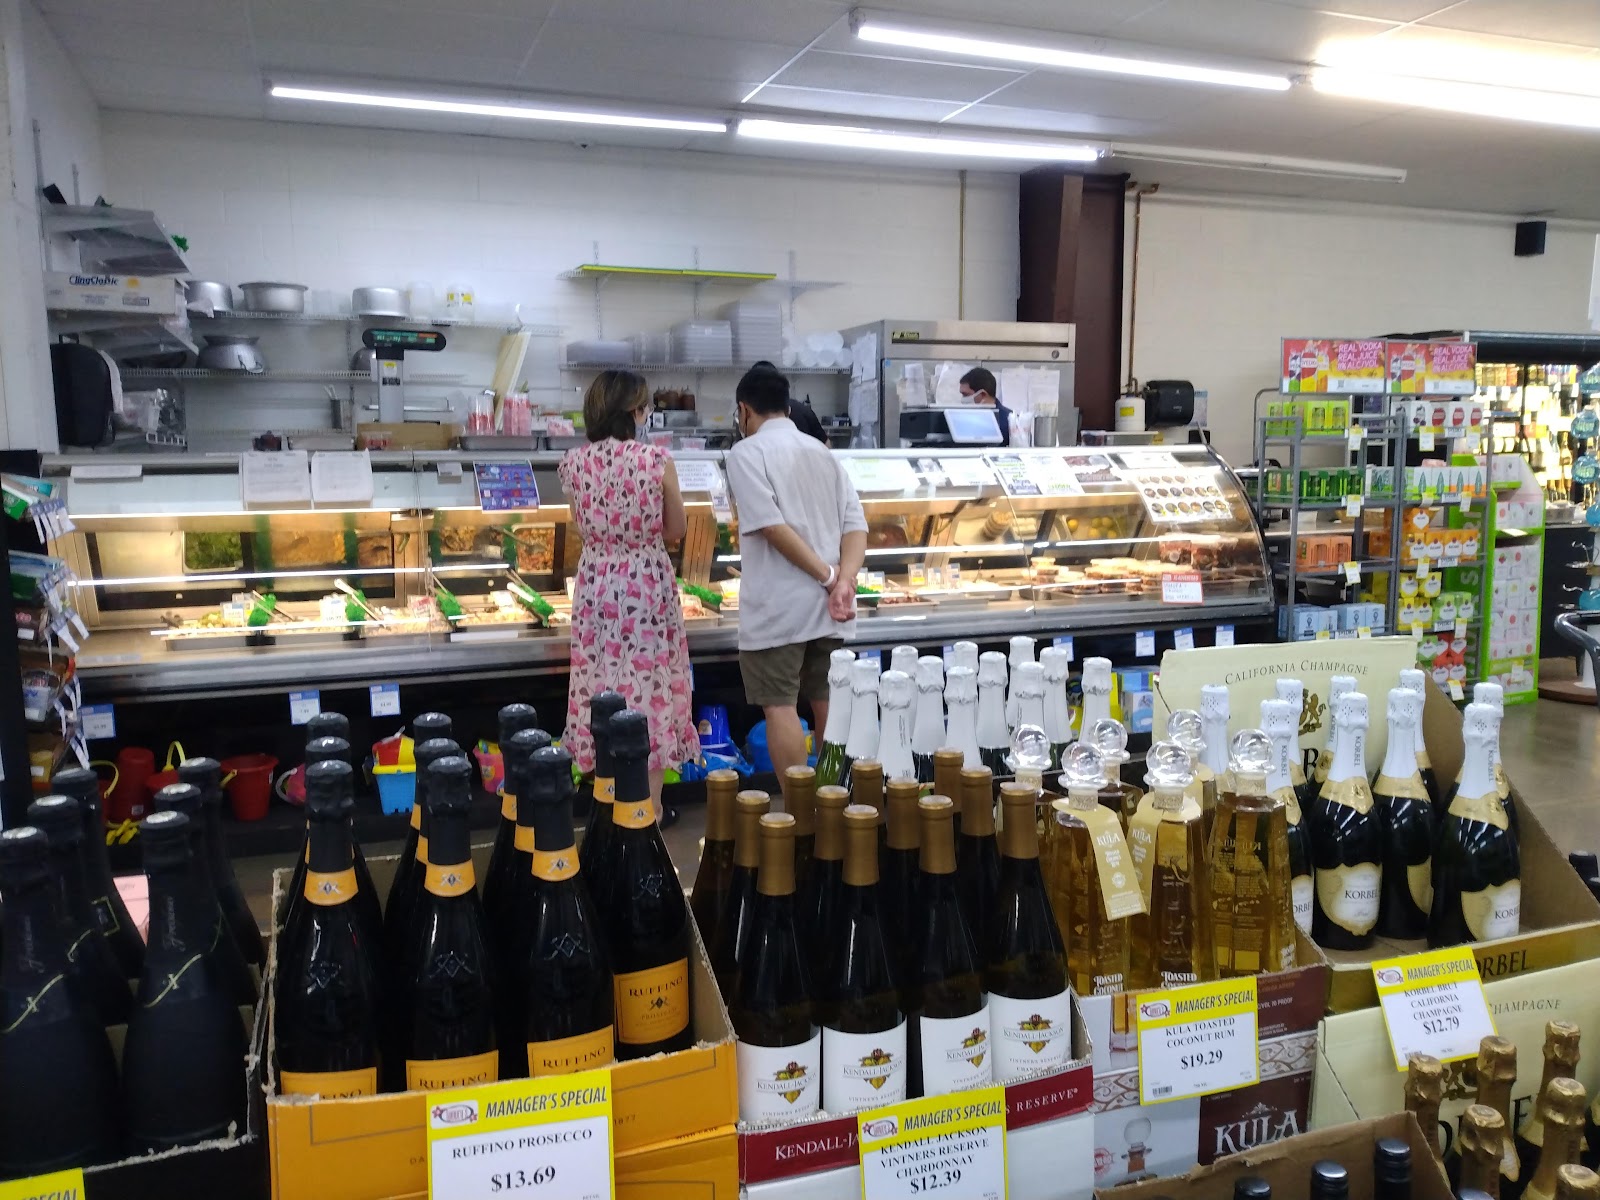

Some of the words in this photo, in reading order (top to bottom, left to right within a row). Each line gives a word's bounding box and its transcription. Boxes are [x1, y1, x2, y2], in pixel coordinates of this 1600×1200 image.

[1338, 343, 1357, 352] REAL
[1359, 341, 1383, 350] VODKA
[1338, 352, 1356, 361] REAL
[1357, 351, 1378, 360] JUICE
[1434, 347, 1450, 356] REAL
[1452, 345, 1473, 354] VODKA
[1433, 356, 1449, 364] REAL
[1452, 354, 1468, 363] JUICE
[1225, 662, 1296, 685] CALIFORNIA
[1300, 659, 1369, 676] CHAMPAGNE
[1353, 736, 1361, 767] KORBEL
[1487, 749, 1495, 782] KORBEL
[1096, 832, 1121, 847] KULA
[1344, 889, 1379, 900] KORBEL
[1093, 973, 1123, 986] TOASTED
[1161, 970, 1197, 982] TOASTED
[1406, 961, 1447, 981] MANAGER'S
[1446, 958, 1475, 974] SPECIAL
[629, 976, 684, 997] RUFFINO
[1404, 986, 1436, 998] KORBEL
[1437, 982, 1459, 992] BRUT
[1175, 994, 1222, 1014] MANAGER'S
[1223, 990, 1255, 1006] SPECIAL
[1278, 997, 1293, 1005] PROOF
[1411, 993, 1460, 1009] CALIFORNIA
[1413, 1004, 1464, 1021] CHAMPAGNE
[1165, 1025, 1192, 1037] KULA
[1194, 1016, 1236, 1032] TOASTED
[1423, 1016, 1461, 1036] $12.79
[1167, 1033, 1213, 1049] COCONUT
[1214, 1029, 1236, 1041] RUM
[542, 1045, 607, 1069] RUFFINO
[1180, 1049, 1224, 1071] $19.29
[419, 1071, 488, 1089] RUFFINO
[486, 1093, 557, 1119] MANAGER'S
[560, 1086, 607, 1109] SPECIAL
[904, 1109, 962, 1131] MANAGER'S
[964, 1100, 1002, 1121] SPECIAL
[881, 1136, 935, 1155] KENDALL
[936, 1126, 988, 1144] JACKSON
[1214, 1109, 1300, 1155] KULA
[452, 1139, 515, 1159] RUFFINO
[518, 1128, 593, 1148] PROSECCO
[880, 1148, 936, 1169] VINTNERS
[938, 1138, 990, 1159] RESERVE
[896, 1154, 975, 1179] CHARDONNAY
[491, 1165, 556, 1193] $13.69
[910, 1168, 962, 1195] $12.39
